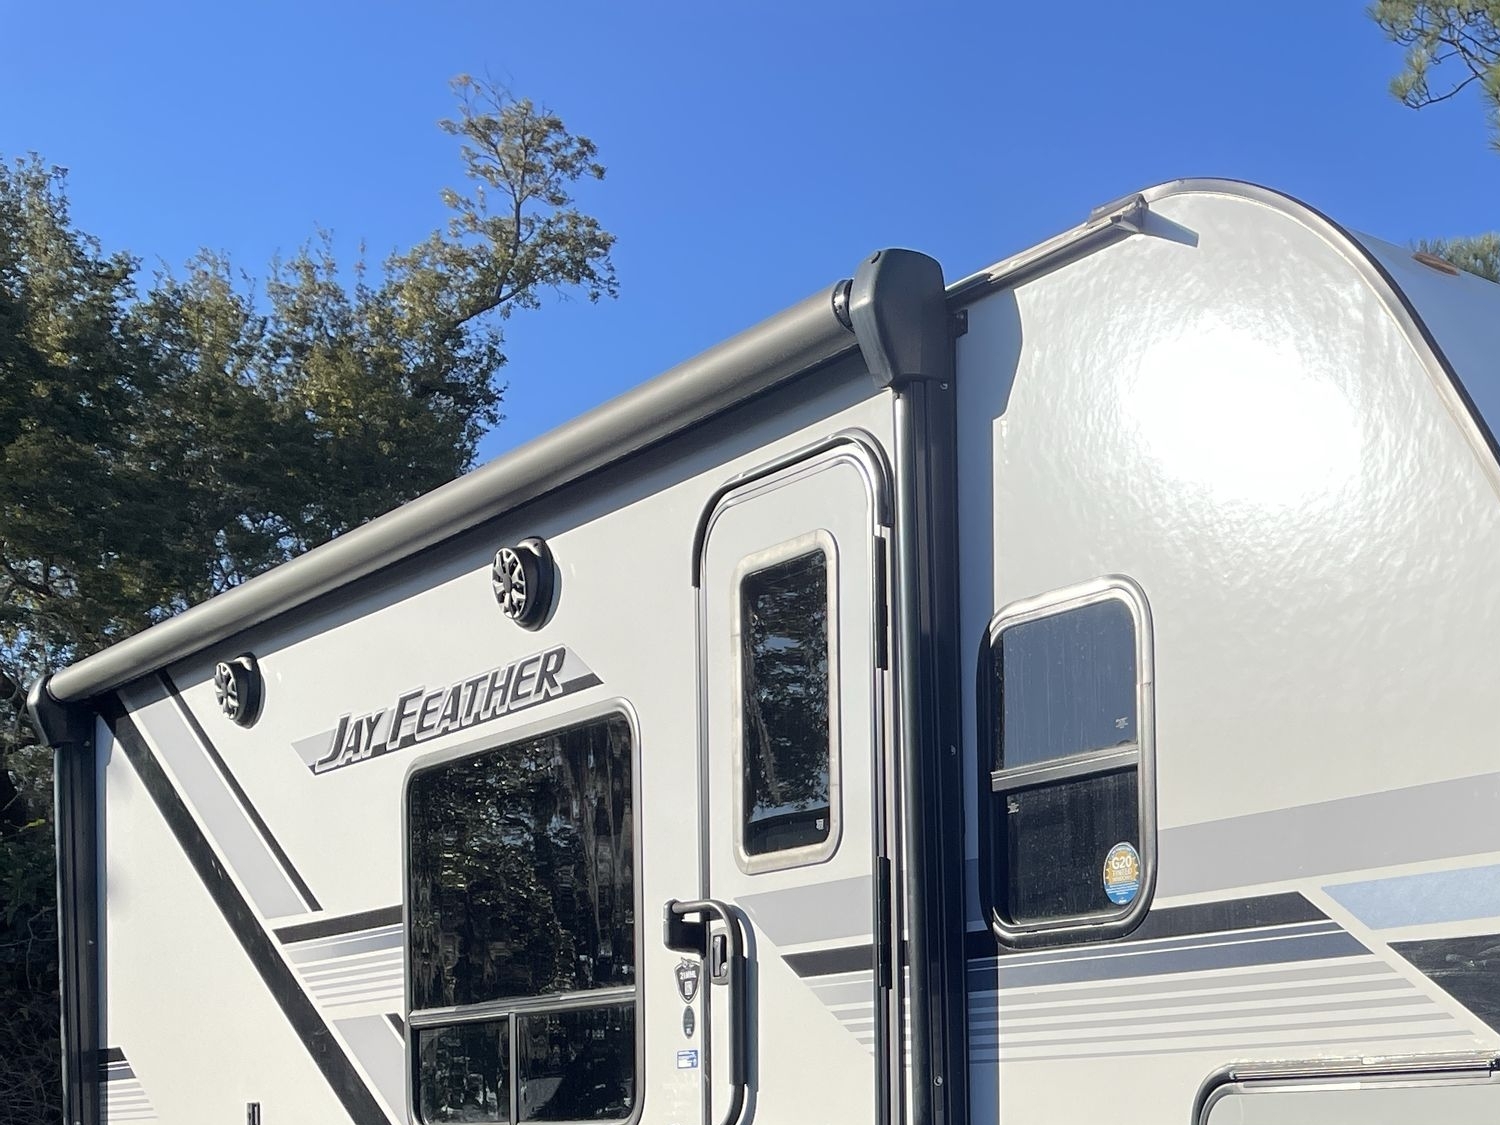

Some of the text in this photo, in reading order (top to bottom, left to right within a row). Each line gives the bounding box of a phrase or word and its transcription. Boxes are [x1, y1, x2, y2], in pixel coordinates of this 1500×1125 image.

[316, 645, 568, 767] JAY FEATHER
[1111, 855, 1132, 870] G20
